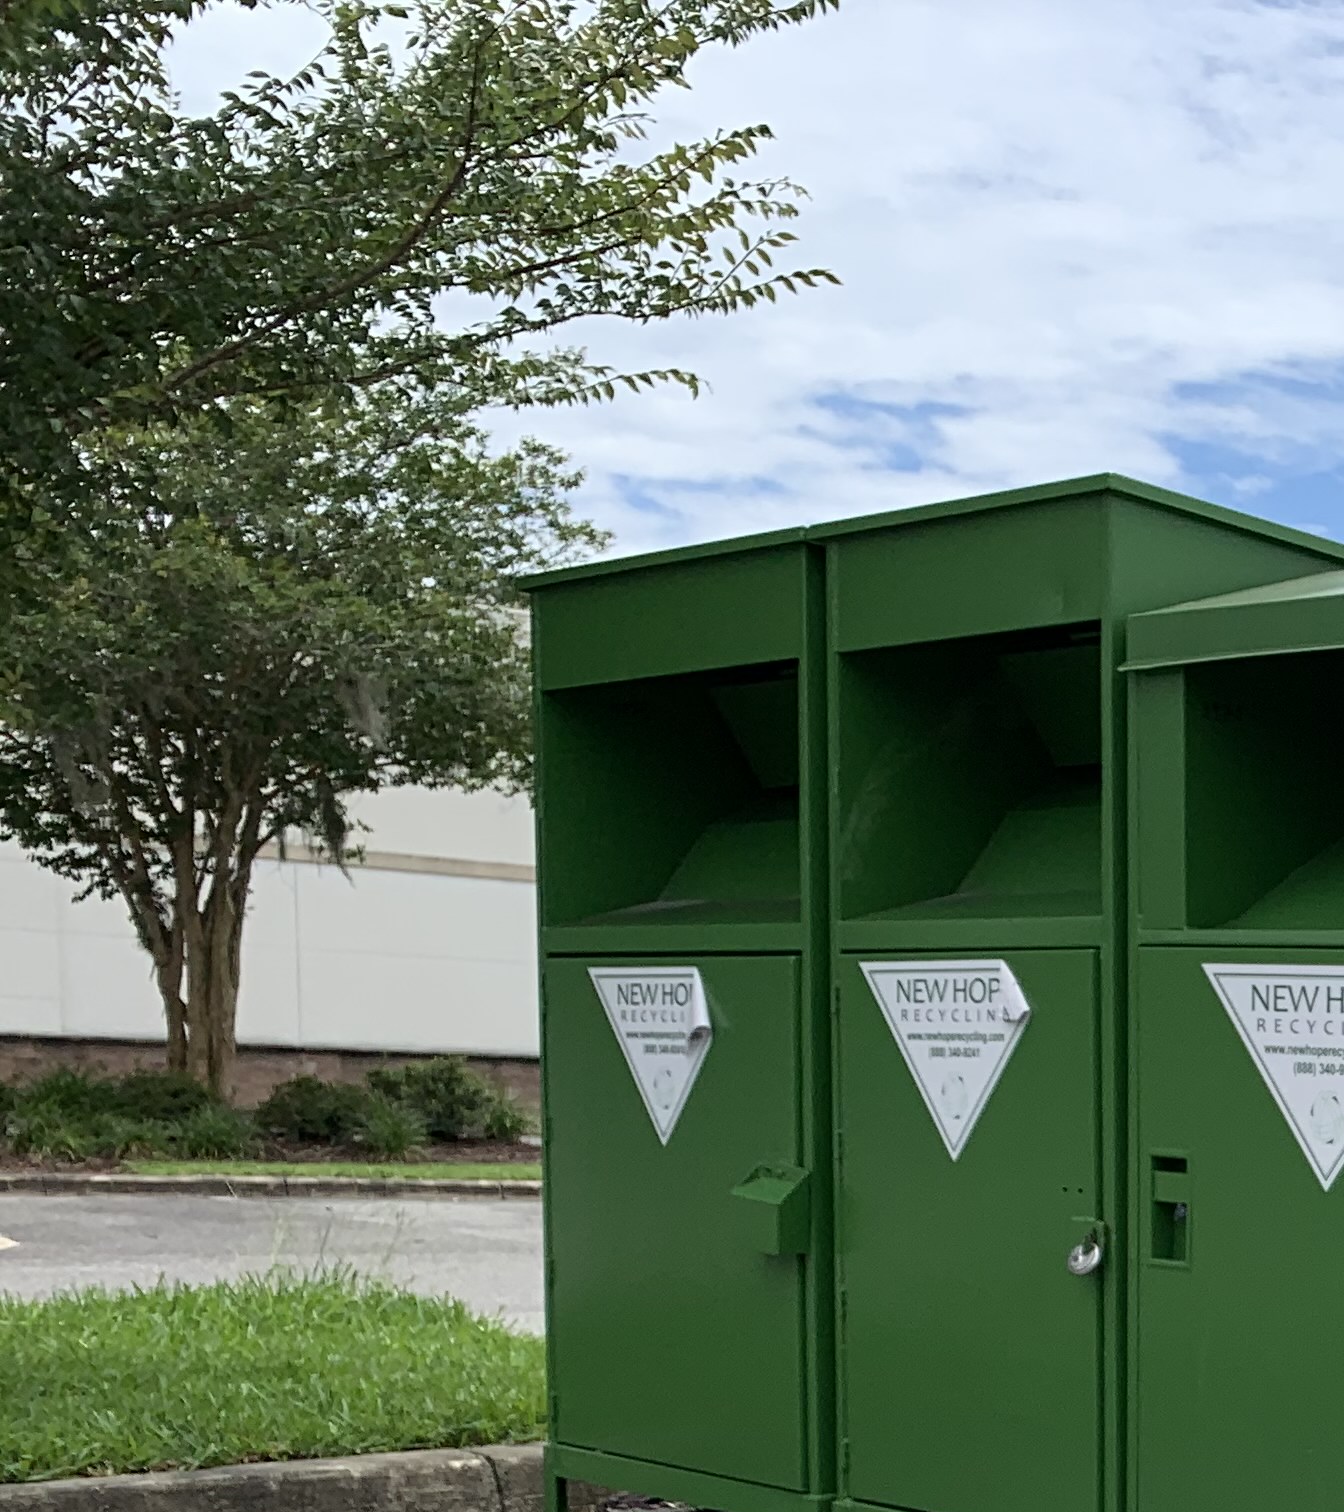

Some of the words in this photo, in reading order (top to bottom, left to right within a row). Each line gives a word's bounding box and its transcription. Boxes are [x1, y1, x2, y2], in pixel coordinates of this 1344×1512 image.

[617, 983, 659, 1006] NEW
[896, 978, 949, 1004] NEW
[952, 978, 1001, 1004] HOP
[1251, 984, 1319, 1013] NEW
[1292, 1061, 1317, 1076] (888)
